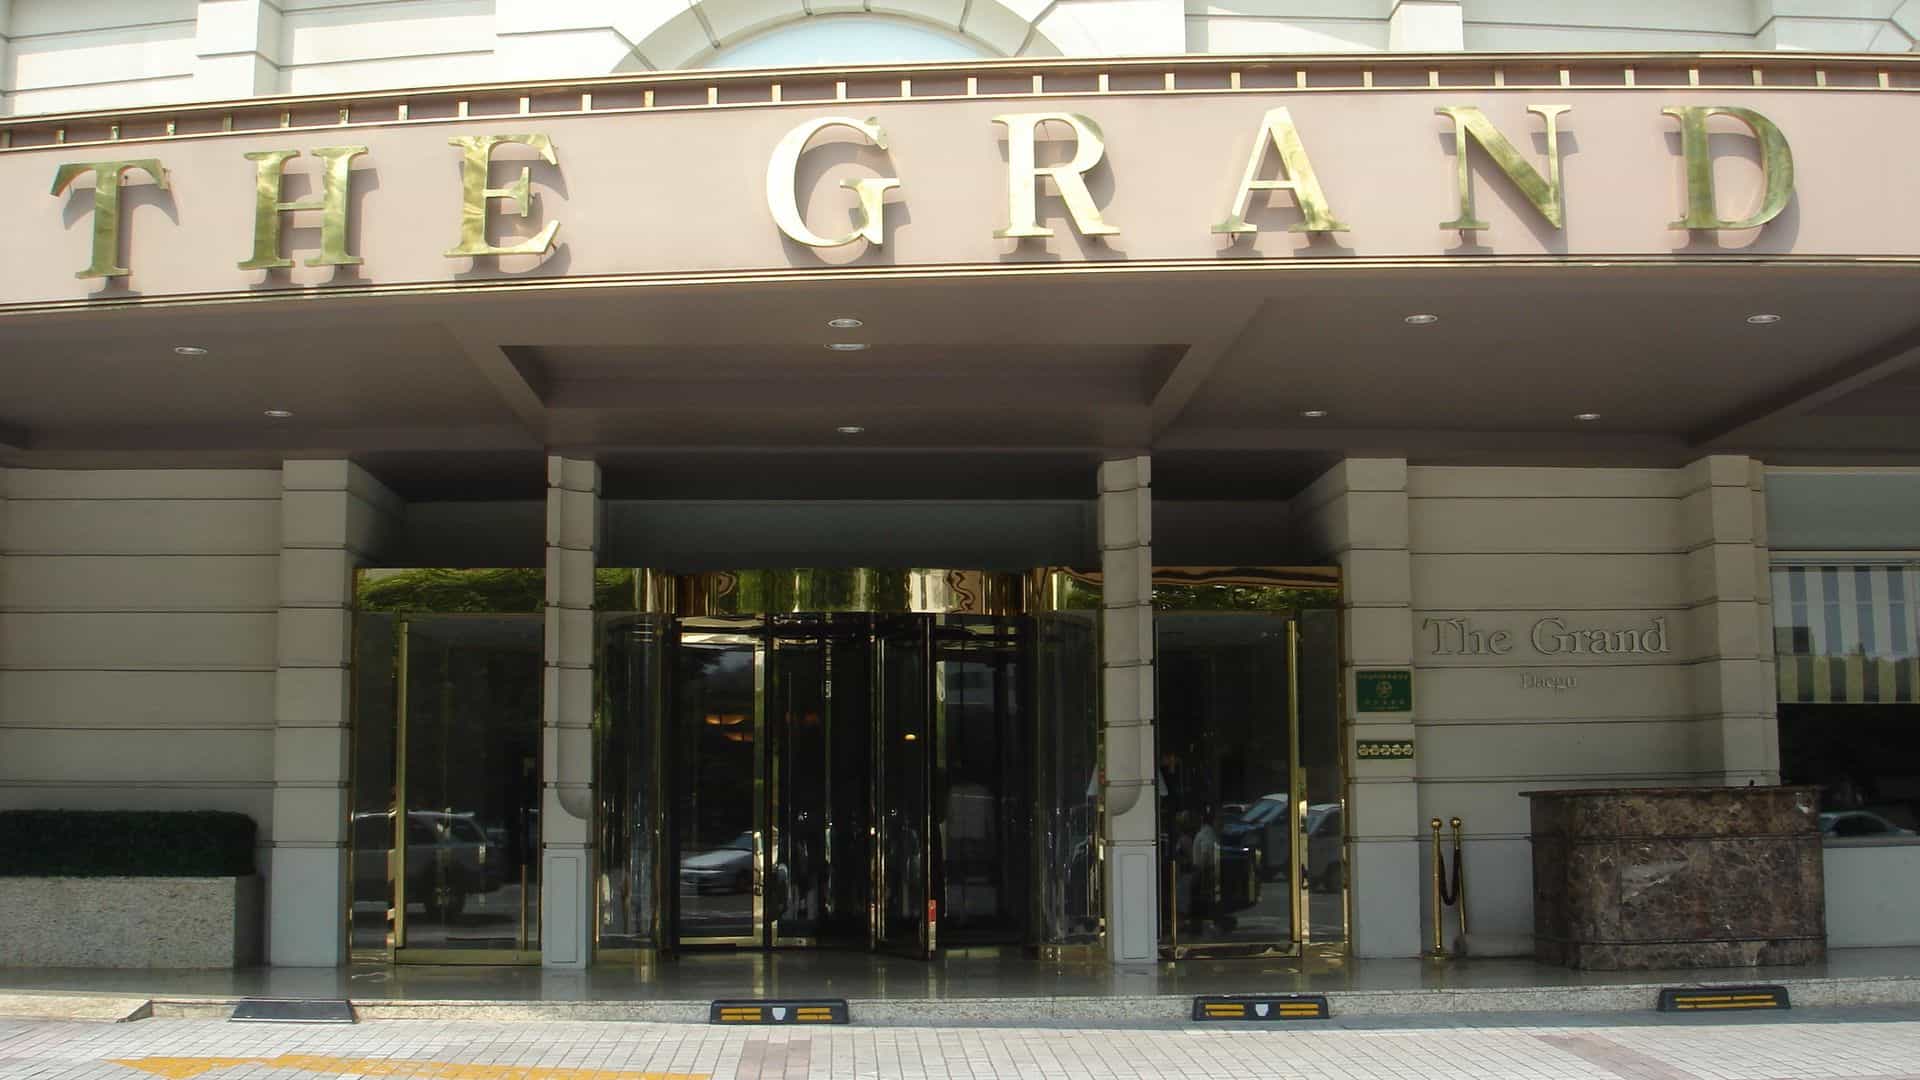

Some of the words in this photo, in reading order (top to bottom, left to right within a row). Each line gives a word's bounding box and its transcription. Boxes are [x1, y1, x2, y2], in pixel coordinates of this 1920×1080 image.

[49, 133, 561, 279] THE
[764, 103, 1796, 248] GRAND
[1422, 615, 1513, 656] The
[1530, 615, 1672, 656] Grand
